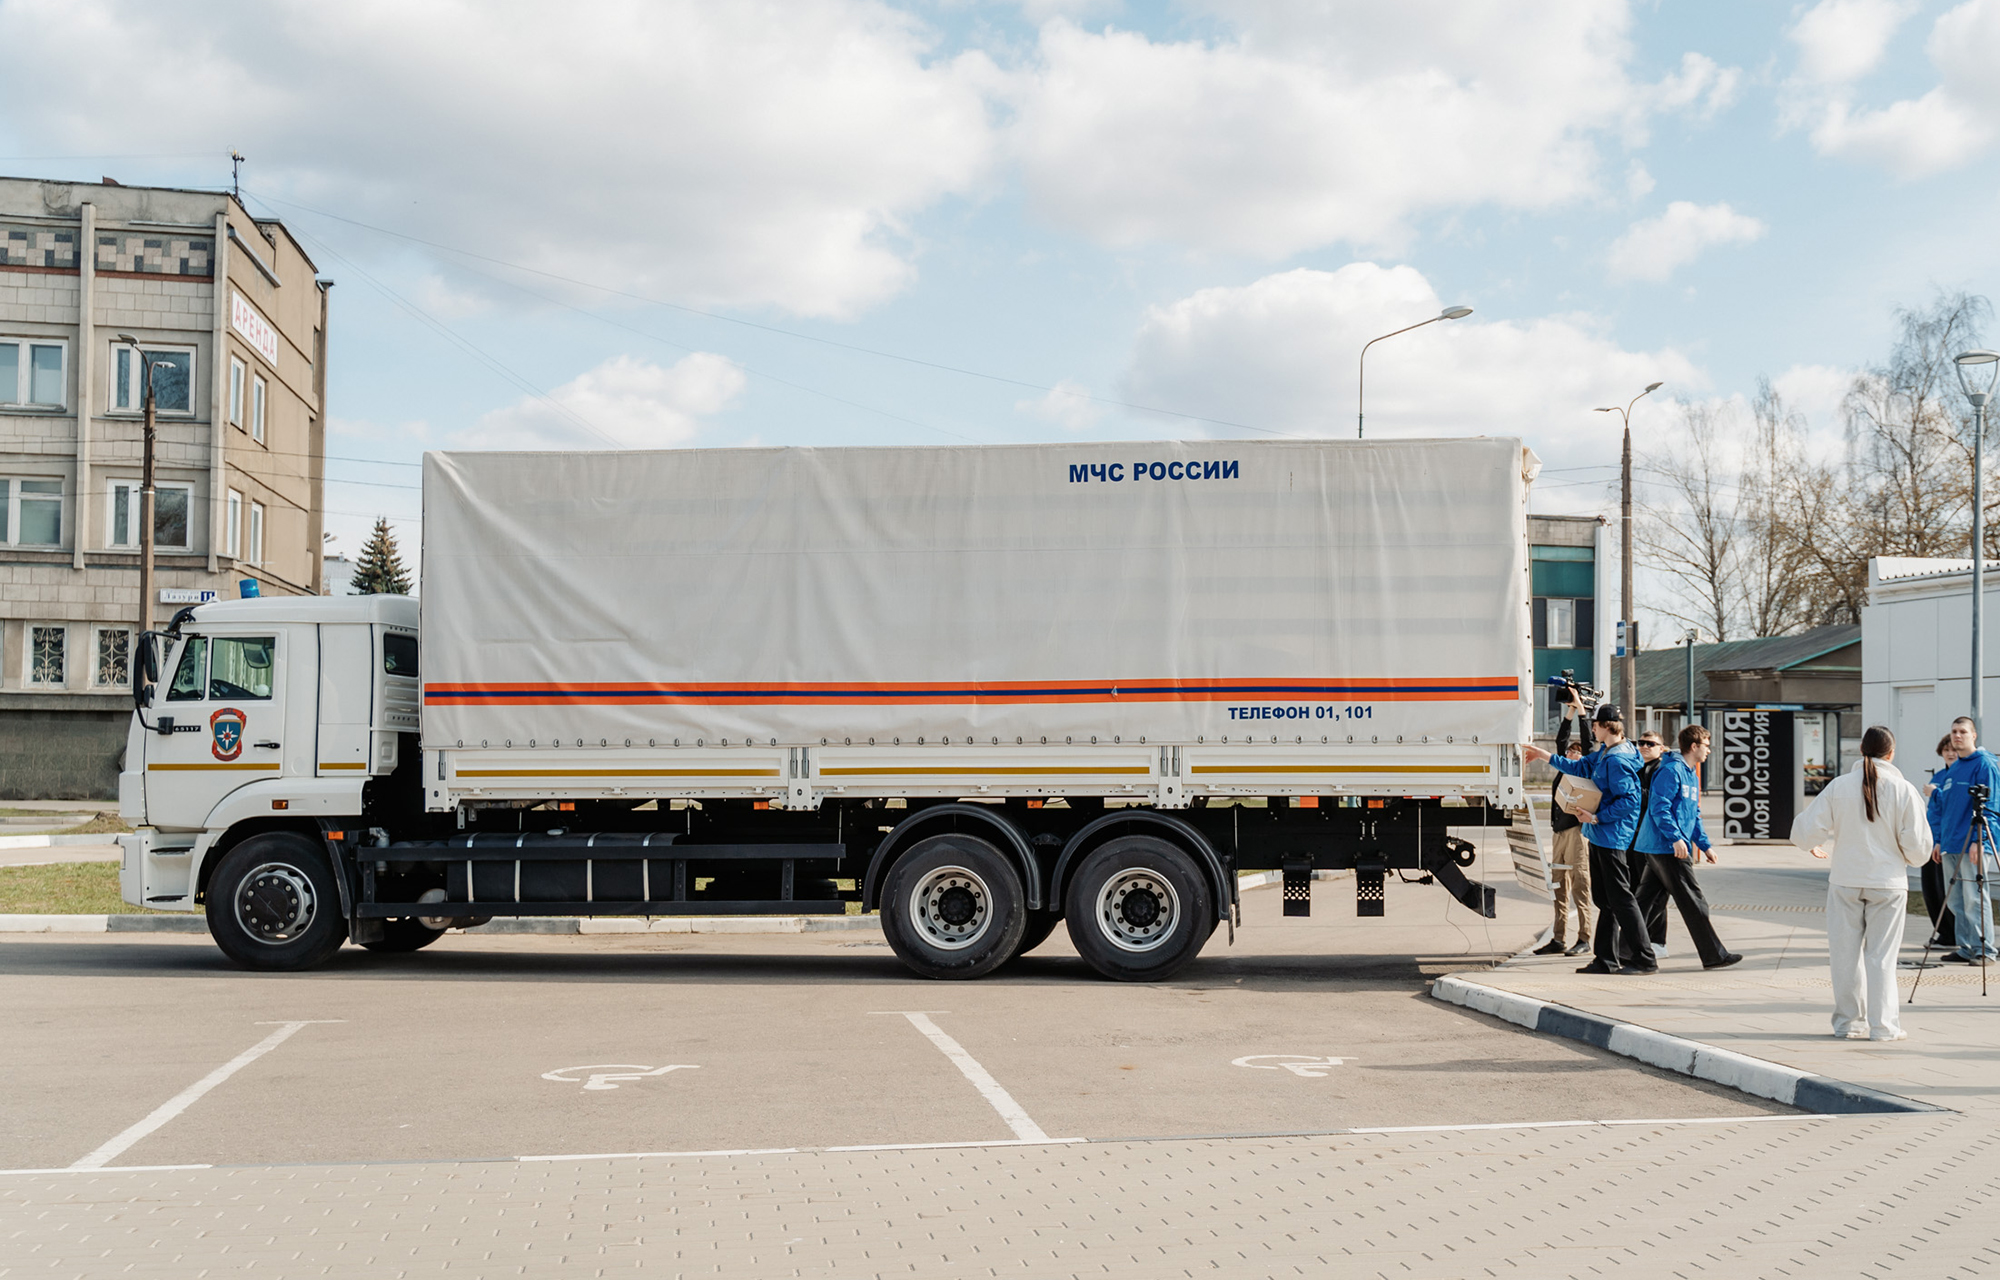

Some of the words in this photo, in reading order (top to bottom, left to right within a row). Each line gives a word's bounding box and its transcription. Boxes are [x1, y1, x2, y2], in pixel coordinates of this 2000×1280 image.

[235, 300, 275, 360] АРЕНДА
[1069, 463, 1125, 483] МЧС
[1133, 460, 1239, 481] РОССИИ
[1228, 706, 1310, 720] ТЕЛЕФОН
[1315, 706, 1340, 721] 01,
[1345, 705, 1372, 719] 101
[1724, 711, 1751, 839] РОССИЯ
[1754, 711, 1770, 795] ИСТОРИЯ
[1754, 799, 1770, 839] МОЯ
